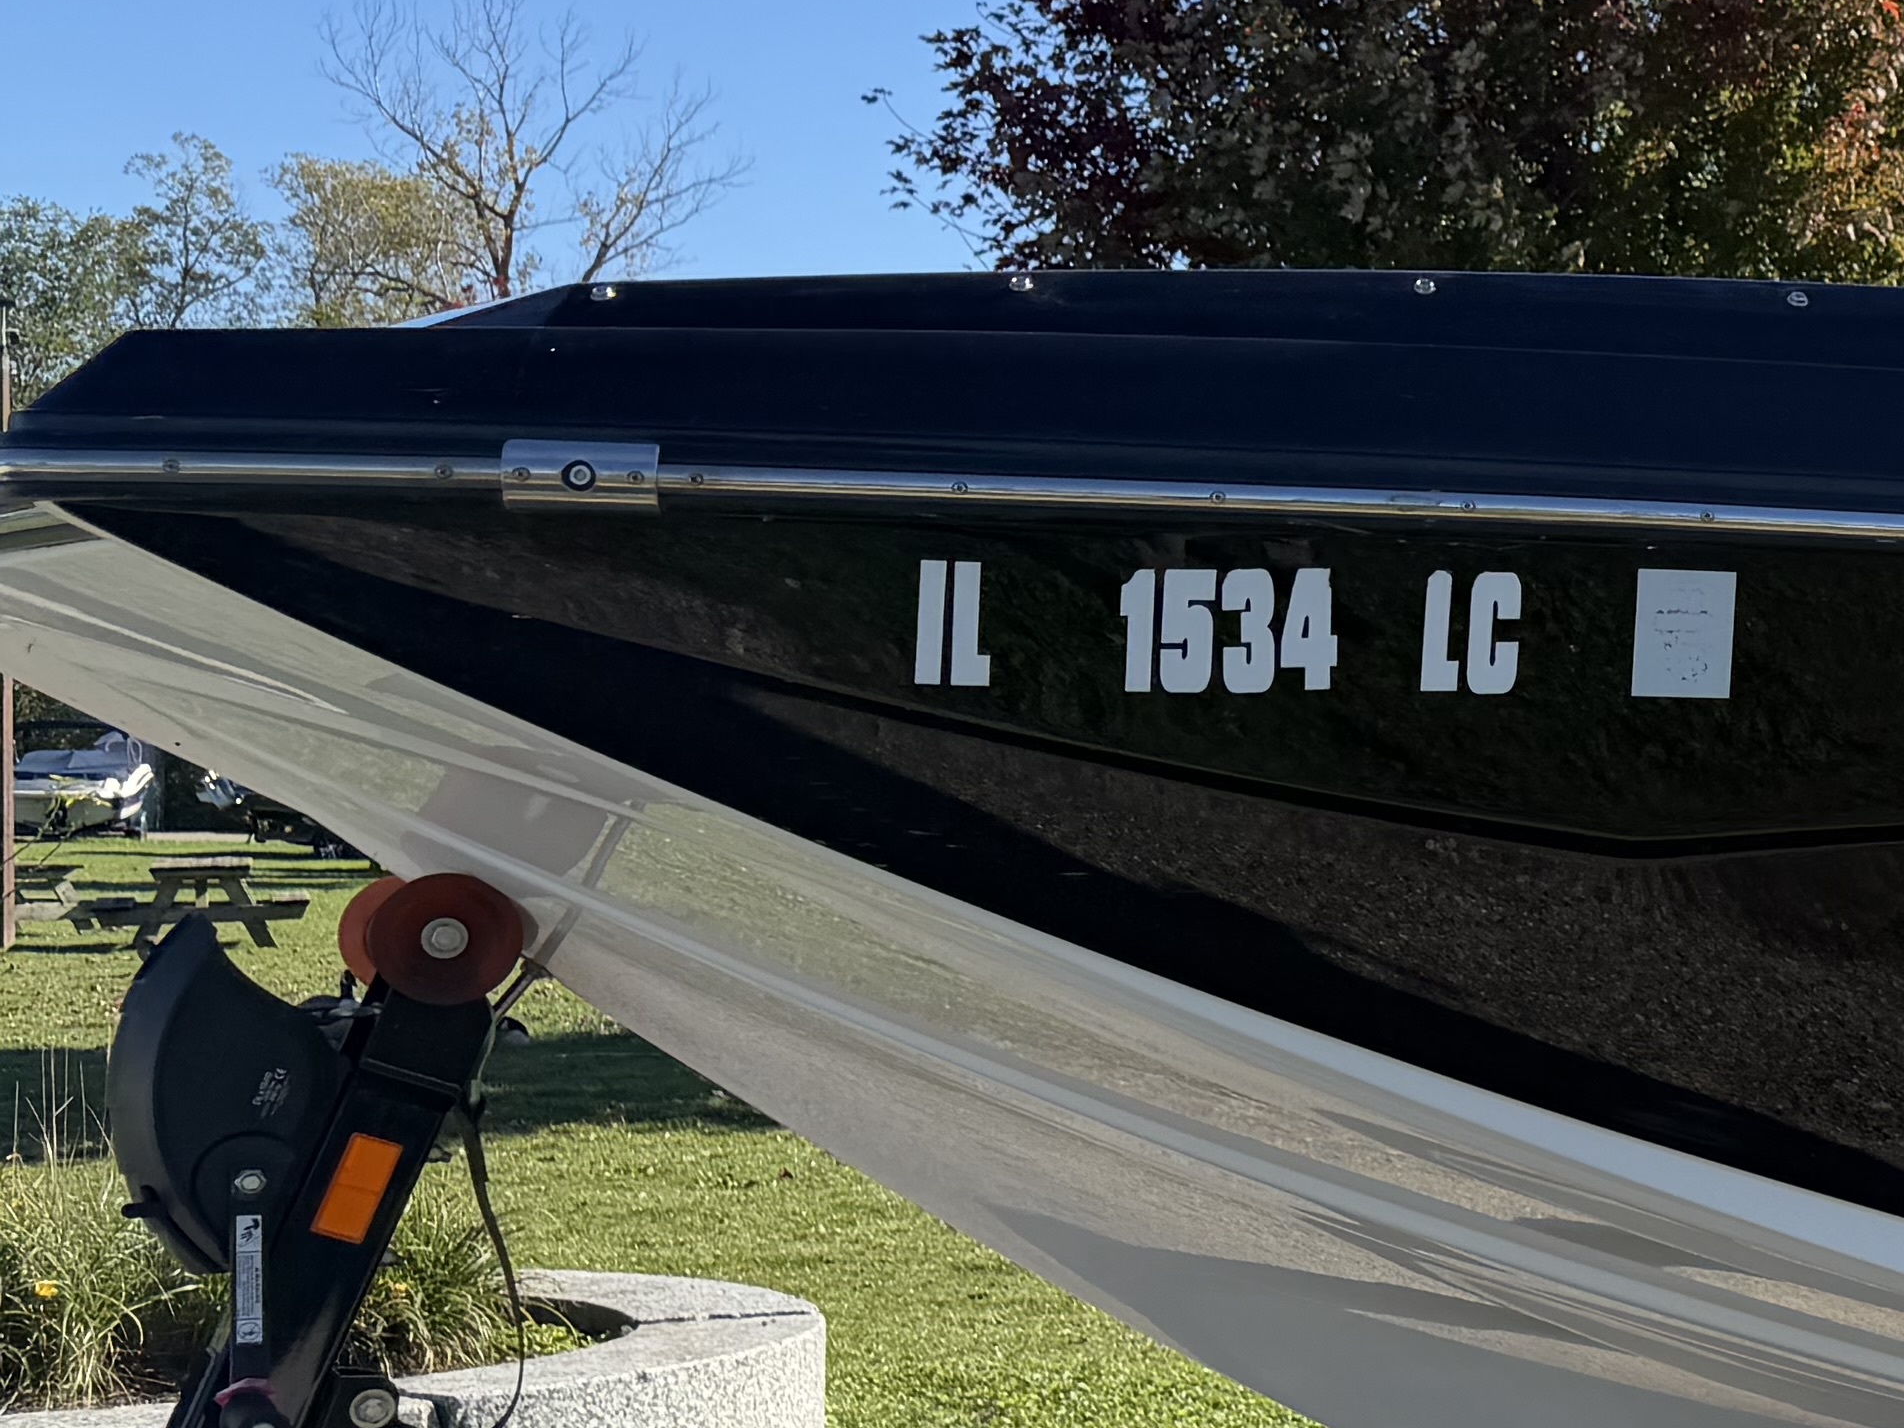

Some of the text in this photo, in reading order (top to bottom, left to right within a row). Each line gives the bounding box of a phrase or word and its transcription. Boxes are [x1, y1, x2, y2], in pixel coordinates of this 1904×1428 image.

[914, 558, 992, 687] IL
[1119, 566, 1339, 696] 1534
[1419, 568, 1522, 696] LC
